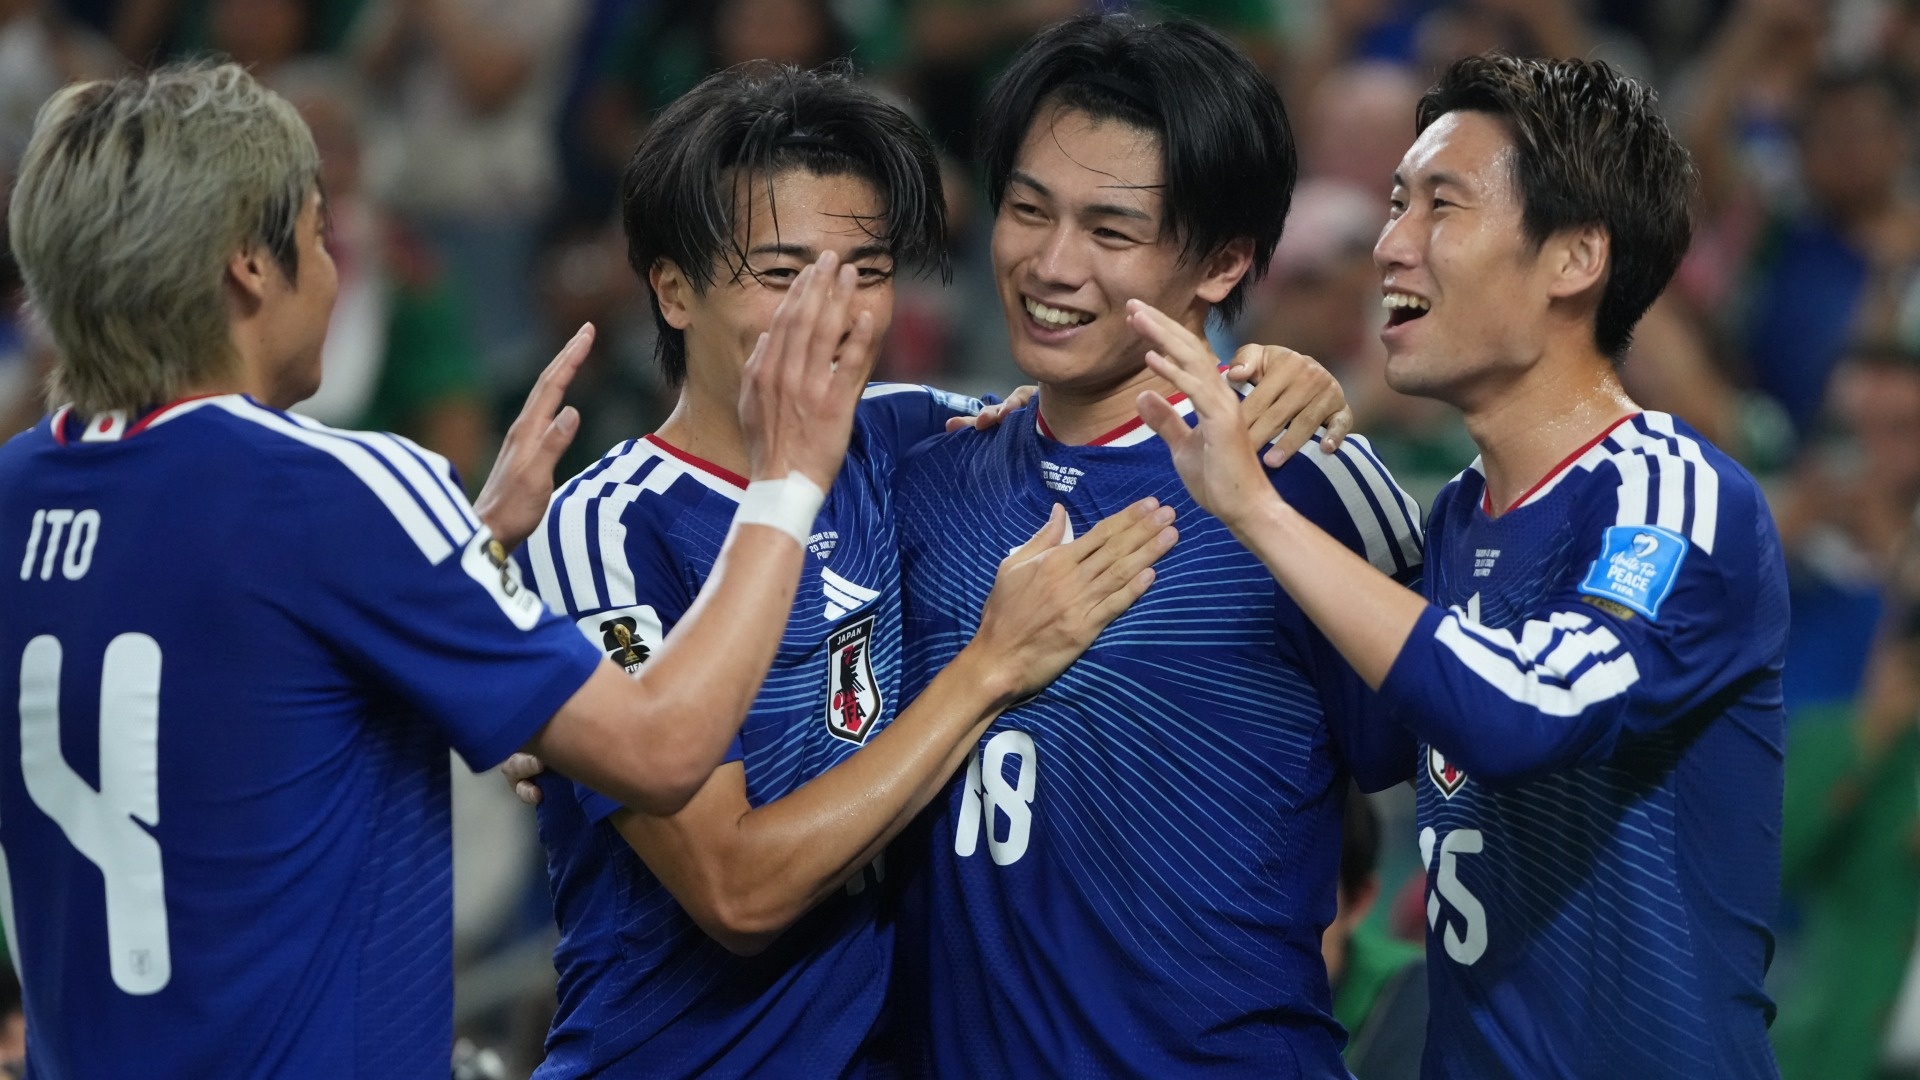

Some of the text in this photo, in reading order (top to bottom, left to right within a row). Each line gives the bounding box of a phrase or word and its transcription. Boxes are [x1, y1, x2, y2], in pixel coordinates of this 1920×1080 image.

[20, 508, 101, 581] ITO
[809, 544, 820, 553] 20
[1606, 564, 1650, 592] PEACE
[1610, 581, 1634, 597] FIFA
[837, 626, 862, 646] JAPAN
[840, 701, 867, 728] JFA
[955, 730, 1037, 866] 18
[19, 632, 171, 995] 4
